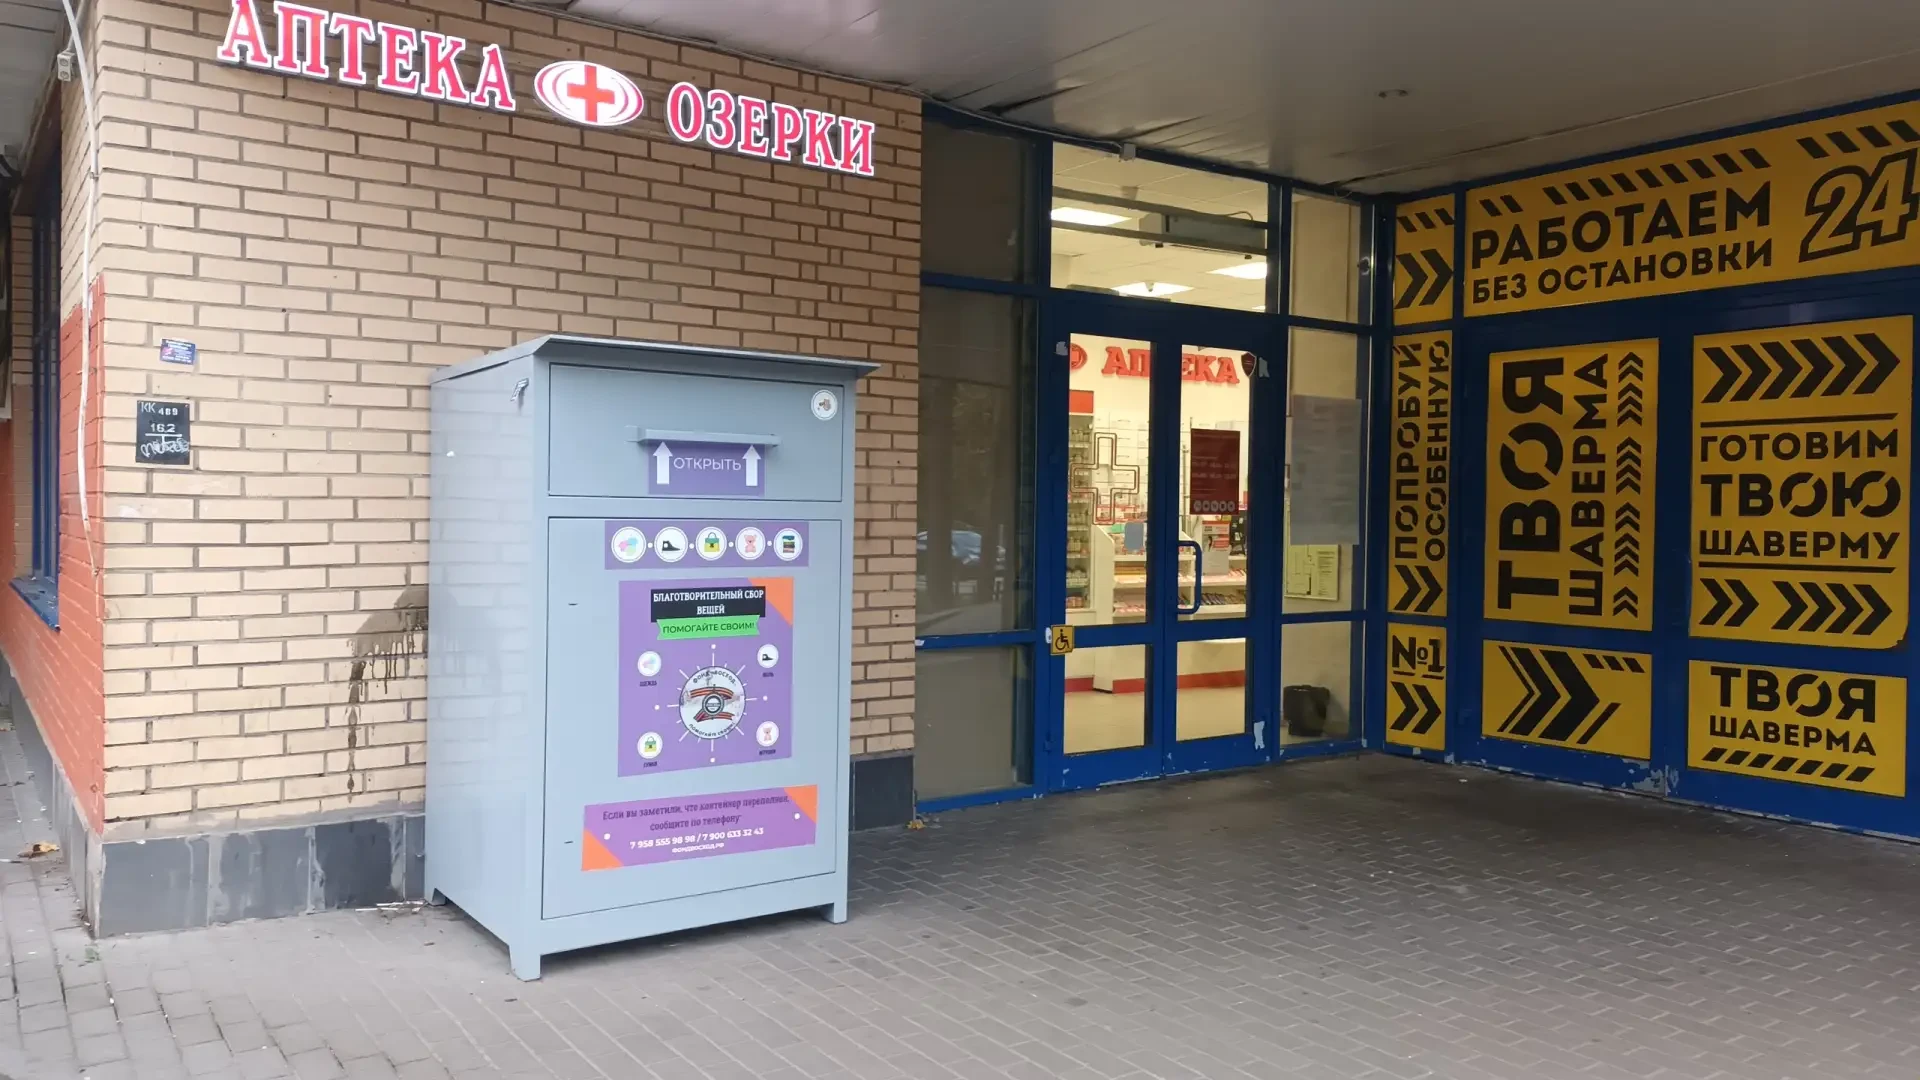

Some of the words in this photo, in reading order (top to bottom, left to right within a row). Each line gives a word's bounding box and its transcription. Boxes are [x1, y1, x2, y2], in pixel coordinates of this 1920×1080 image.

[217, 0, 516, 111] АПТЕКА
[666, 82, 876, 177] ОЗЕРКИ
[1472, 181, 1770, 269] РАБОТАЕМ
[1473, 273, 1527, 304] БЕЗ
[1538, 238, 1772, 293] ОСТАНОВКИ
[1101, 346, 1240, 384] АПЕКА
[673, 457, 742, 471] ОТКРЫТЬ
[1394, 343, 1422, 559] ПОПРОБУЙ
[1425, 340, 1450, 561] ОСОБЕННУЮ
[1700, 429, 1898, 462] ГОТОВИМ
[1497, 357, 1564, 609] ТВОЯ
[1569, 354, 1608, 616] ШАВЕРМА
[1701, 470, 1901, 518] ТВОЮ
[1700, 530, 1900, 560] ШАВЕРМУ
[653, 590, 743, 602] БЛАГОТВОРИТЕЛЬНЫЙ
[744, 590, 764, 600] СБОР
[697, 604, 725, 615] ВЕЩЕЙ
[662, 623, 719, 634] ПОМОГАЙТЕ
[720, 622, 755, 631] СВОИМ!
[1710, 666, 1876, 723] ТВОЯ
[1709, 715, 1876, 756] ШАВЕРМА
[603, 810, 624, 820] Если
[626, 809, 637, 817] вы
[685, 804, 698, 812] что
[699, 800, 742, 813] контейнер
[650, 819, 689, 831] сообщите
[691, 818, 702, 828] по
[630, 842, 636, 850] 7
[638, 840, 653, 848] 958
[655, 839, 671, 847] 555
[702, 833, 708, 841] 7
[709, 831, 725, 840] 900
